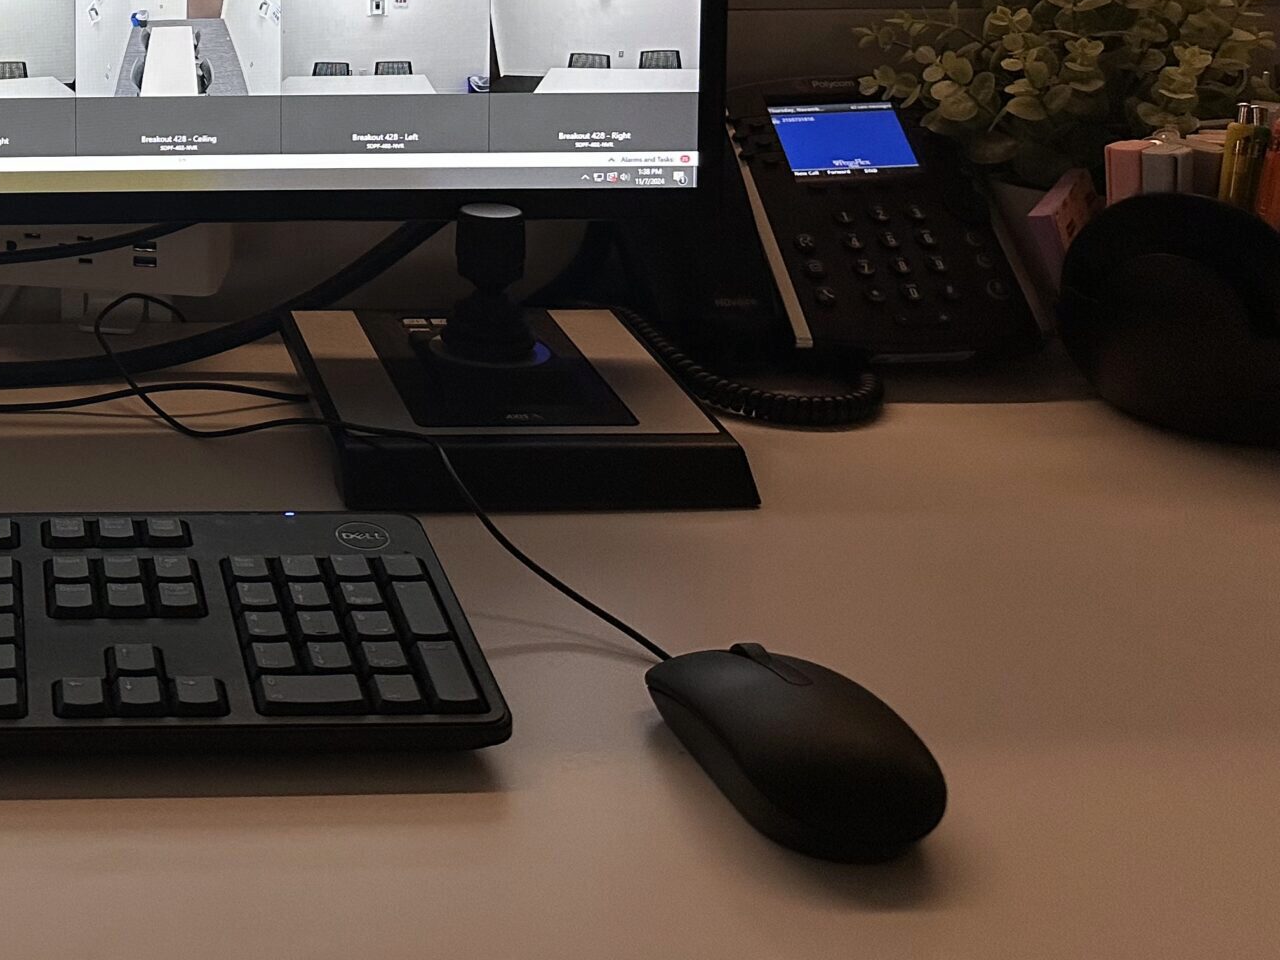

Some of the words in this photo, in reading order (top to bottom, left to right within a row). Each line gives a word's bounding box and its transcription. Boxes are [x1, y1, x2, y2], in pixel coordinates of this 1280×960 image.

[811, 80, 855, 89] Polycom
[142, 136, 172, 144] Breakout
[193, 136, 217, 144] Ceiling
[559, 132, 590, 140] Breakout
[612, 132, 631, 140] Right
[341, 531, 385, 541] DELL
